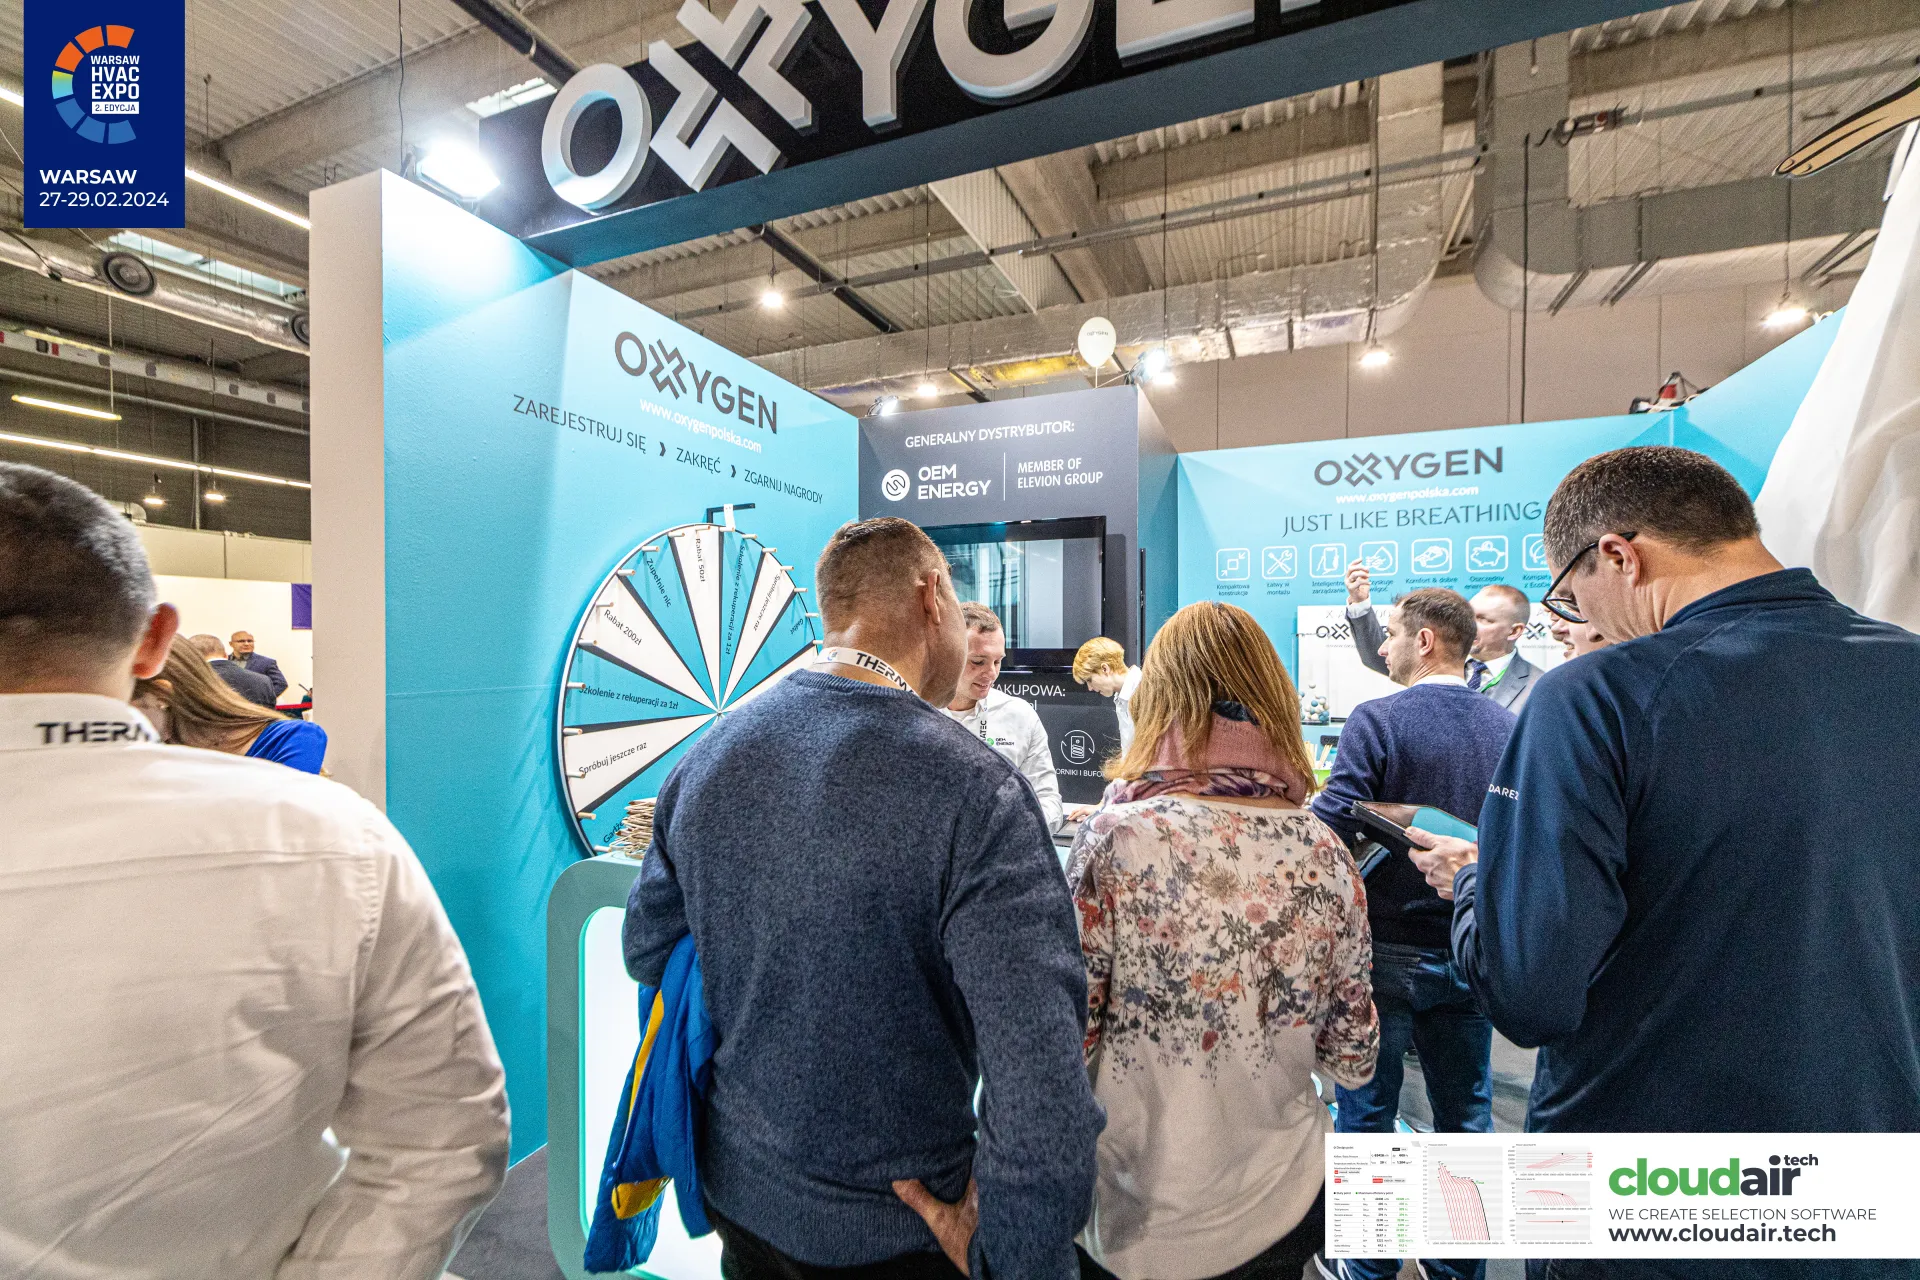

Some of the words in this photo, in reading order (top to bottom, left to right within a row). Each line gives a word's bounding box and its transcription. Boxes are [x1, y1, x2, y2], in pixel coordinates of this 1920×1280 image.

[640, 399, 762, 454] www.oxygenpolska.com
[905, 430, 976, 447] GENERALNY
[979, 420, 1075, 441] DYSTRYBUTOR:
[513, 394, 622, 443] ZAREJESTRUJ
[626, 431, 646, 454] SIĘ
[676, 447, 721, 475] ZAKRĘĆ
[744, 469, 782, 492] ZGARNIJ
[784, 482, 823, 504] NAGRODY
[918, 464, 957, 481] OEM
[1017, 459, 1063, 473] MEMBER
[1067, 458, 1082, 470] OF
[1314, 446, 1503, 487] OXYGEN
[917, 480, 991, 499] ENERGY
[1017, 475, 1061, 488] ELEVION
[1065, 471, 1103, 485] GROUP
[1336, 485, 1479, 504] www.oxygenpolska.com
[1282, 514, 1332, 538] JUST
[1340, 510, 1388, 530] LIKE
[1396, 501, 1542, 527] BREATHING
[604, 609, 624, 628] Rabat
[623, 626, 642, 646] 200zł
[856, 652, 914, 693] THERM
[991, 684, 1066, 697] AKUPOWA:
[622, 694, 660, 708] rekuperacji
[610, 747, 636, 764] jeszcze
[636, 742, 647, 752] raz
[1083, 769, 1105, 778] BUFO
